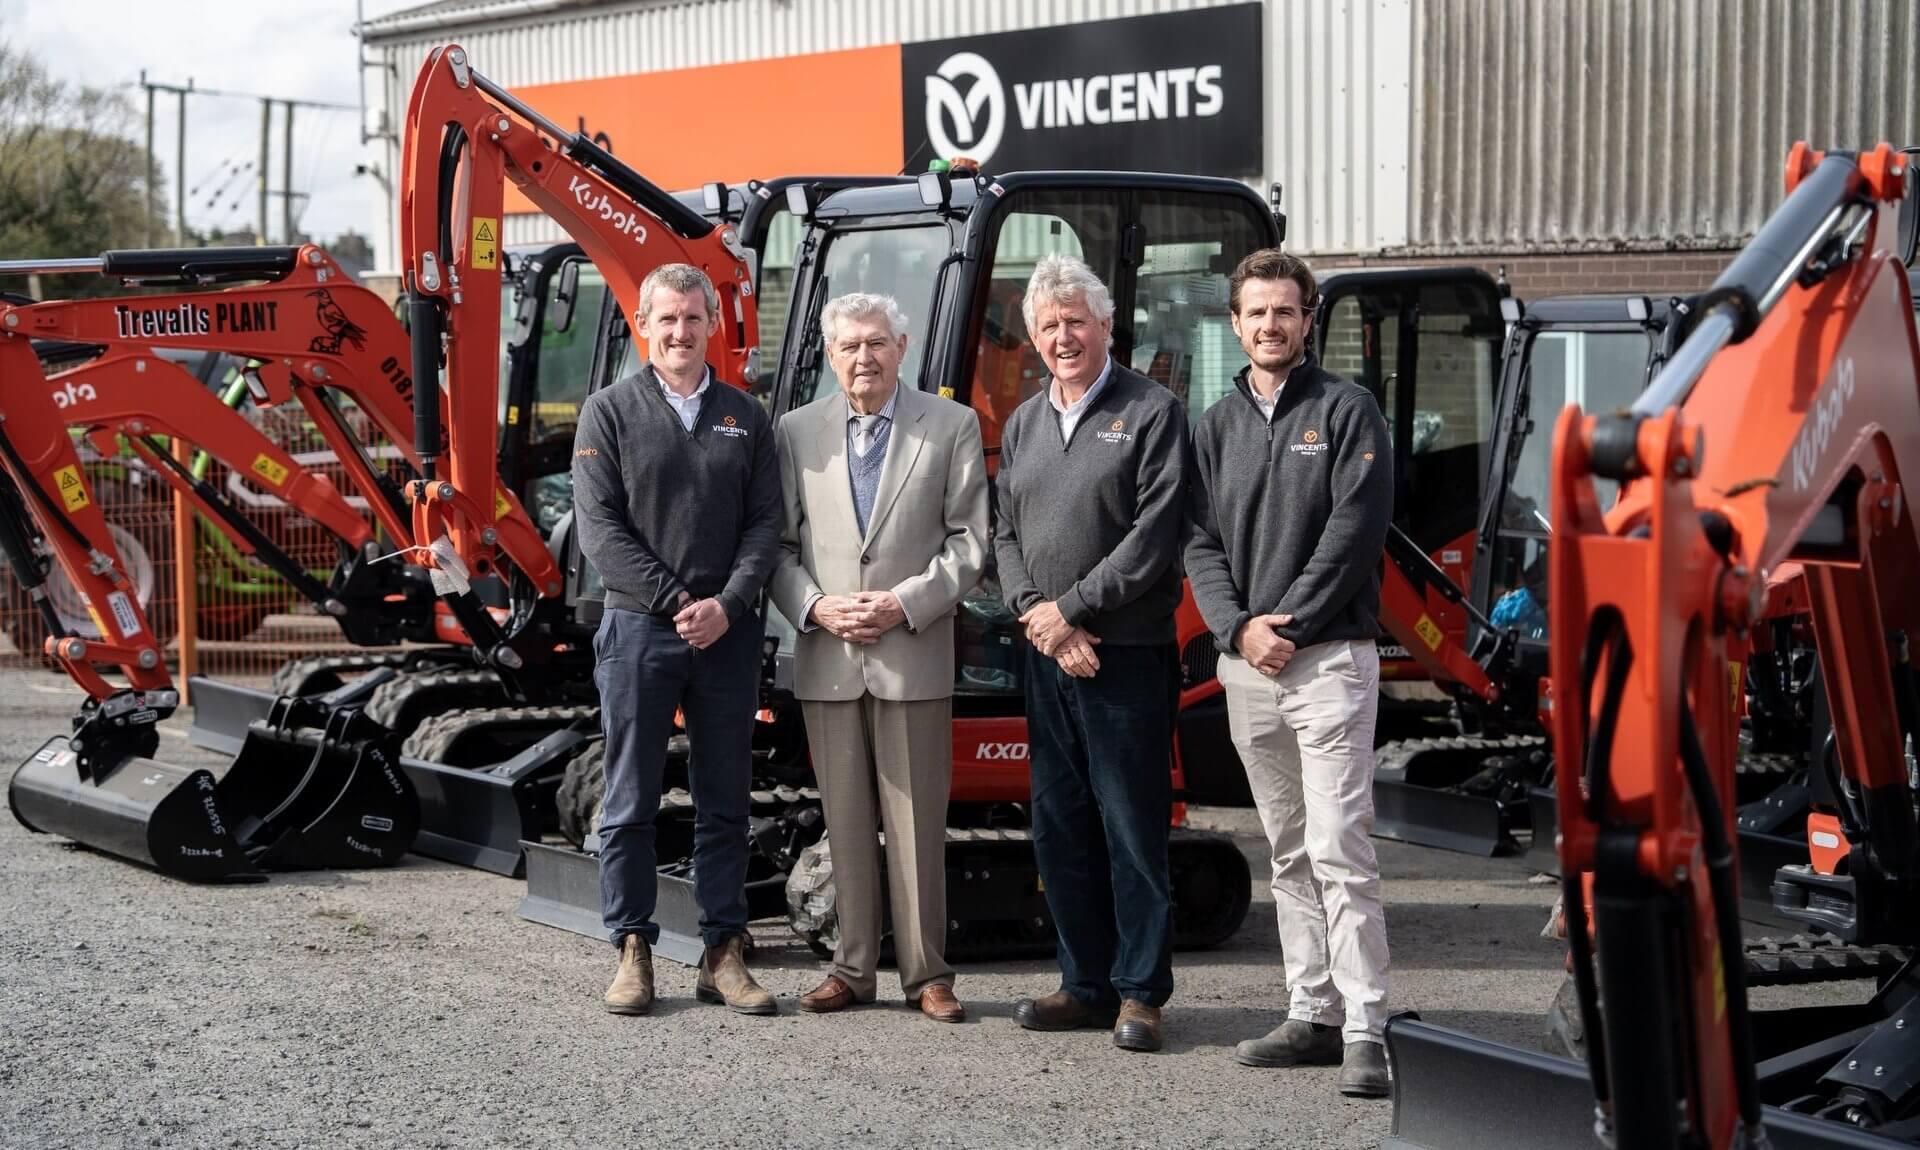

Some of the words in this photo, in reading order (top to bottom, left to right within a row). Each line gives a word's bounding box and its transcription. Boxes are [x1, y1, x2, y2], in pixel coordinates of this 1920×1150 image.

[1013, 64, 1224, 130] VINCENTS
[568, 175, 647, 245] Kubota
[114, 303, 210, 338] Trevails
[215, 301, 278, 333] PLANT
[52, 381, 98, 409] ota
[712, 424, 748, 436] VINCENTS
[1097, 431, 1132, 441] VINCENTS
[1791, 356, 1855, 493] Kubota
[575, 447, 599, 457] ubota
[1290, 443, 1328, 452] VINCENTS
